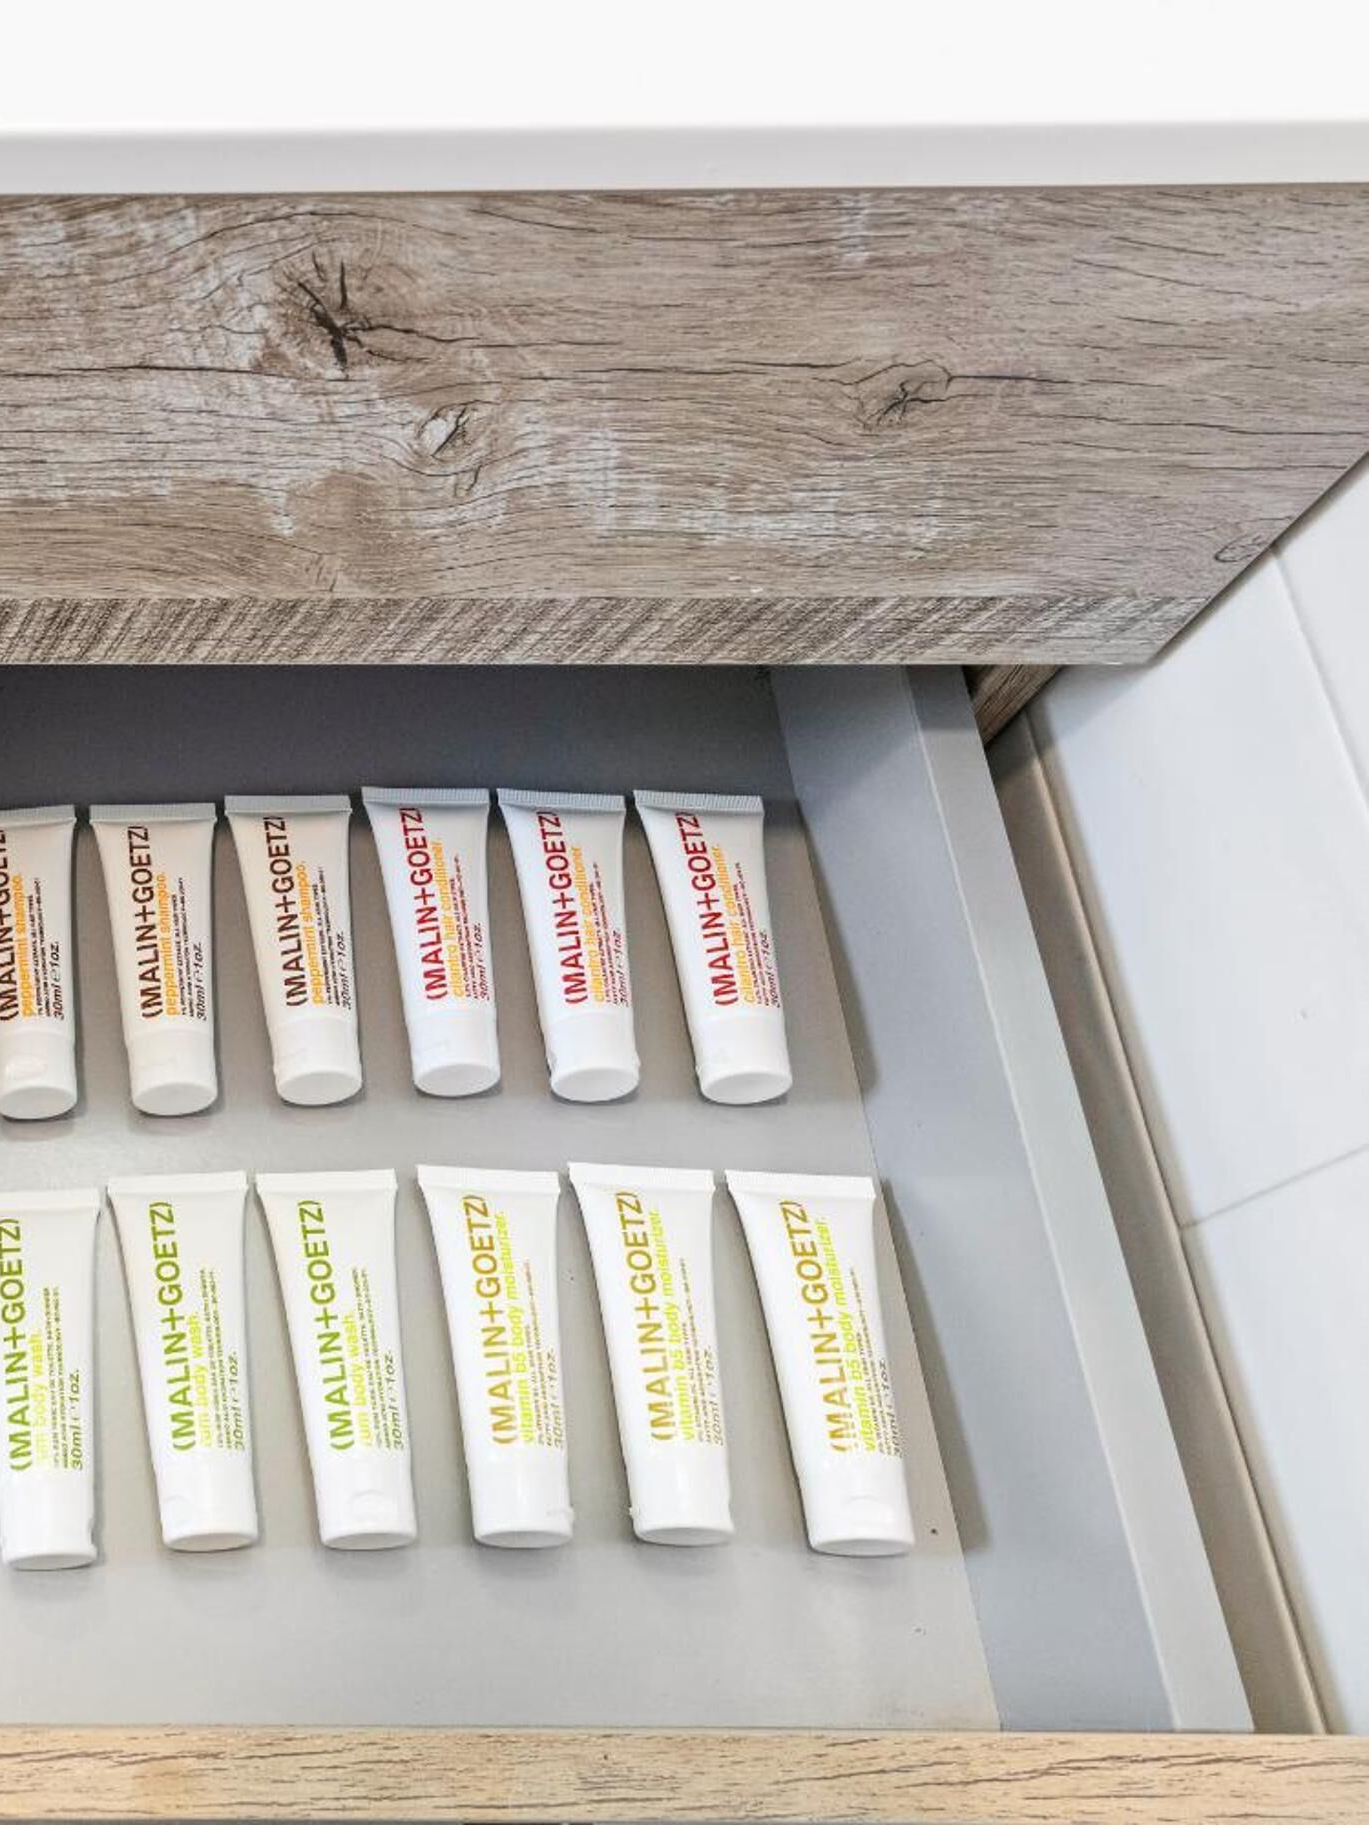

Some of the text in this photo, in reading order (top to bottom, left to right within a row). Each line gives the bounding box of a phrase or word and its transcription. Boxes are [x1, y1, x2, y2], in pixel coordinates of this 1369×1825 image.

[442, 916, 455, 939] hair
[537, 811, 588, 1004] (MALIN+GOETZ)
[675, 812, 738, 1005] (MALIN+GOETZ)
[582, 919, 595, 945] hair
[729, 922, 745, 946] hair
[303, 926, 324, 1004] peppermint
[149, 1202, 195, 1451] (MALIN+GOETZ)
[298, 1200, 354, 1451] (MALIN+GOETZ)
[463, 1195, 517, 1445] (MALIN+GOETZ)
[505, 1305, 525, 1347] body
[615, 1192, 676, 1441] (MALIN+GOETZ)
[663, 1302, 681, 1343] body
[779, 1201, 859, 1452] (MALIN+GOETZ)
[838, 1312, 859, 1353] body
[511, 1351, 526, 1373] b5
[670, 1350, 685, 1370] b5
[847, 1360, 863, 1380] b5
[69, 1369, 80, 1404] 1oz.
[189, 1366, 210, 1408] body
[349, 1364, 367, 1406] body
[518, 1379, 535, 1444] vitamin
[676, 1376, 695, 1441] vitamin
[853, 1387, 876, 1452] vitamin
